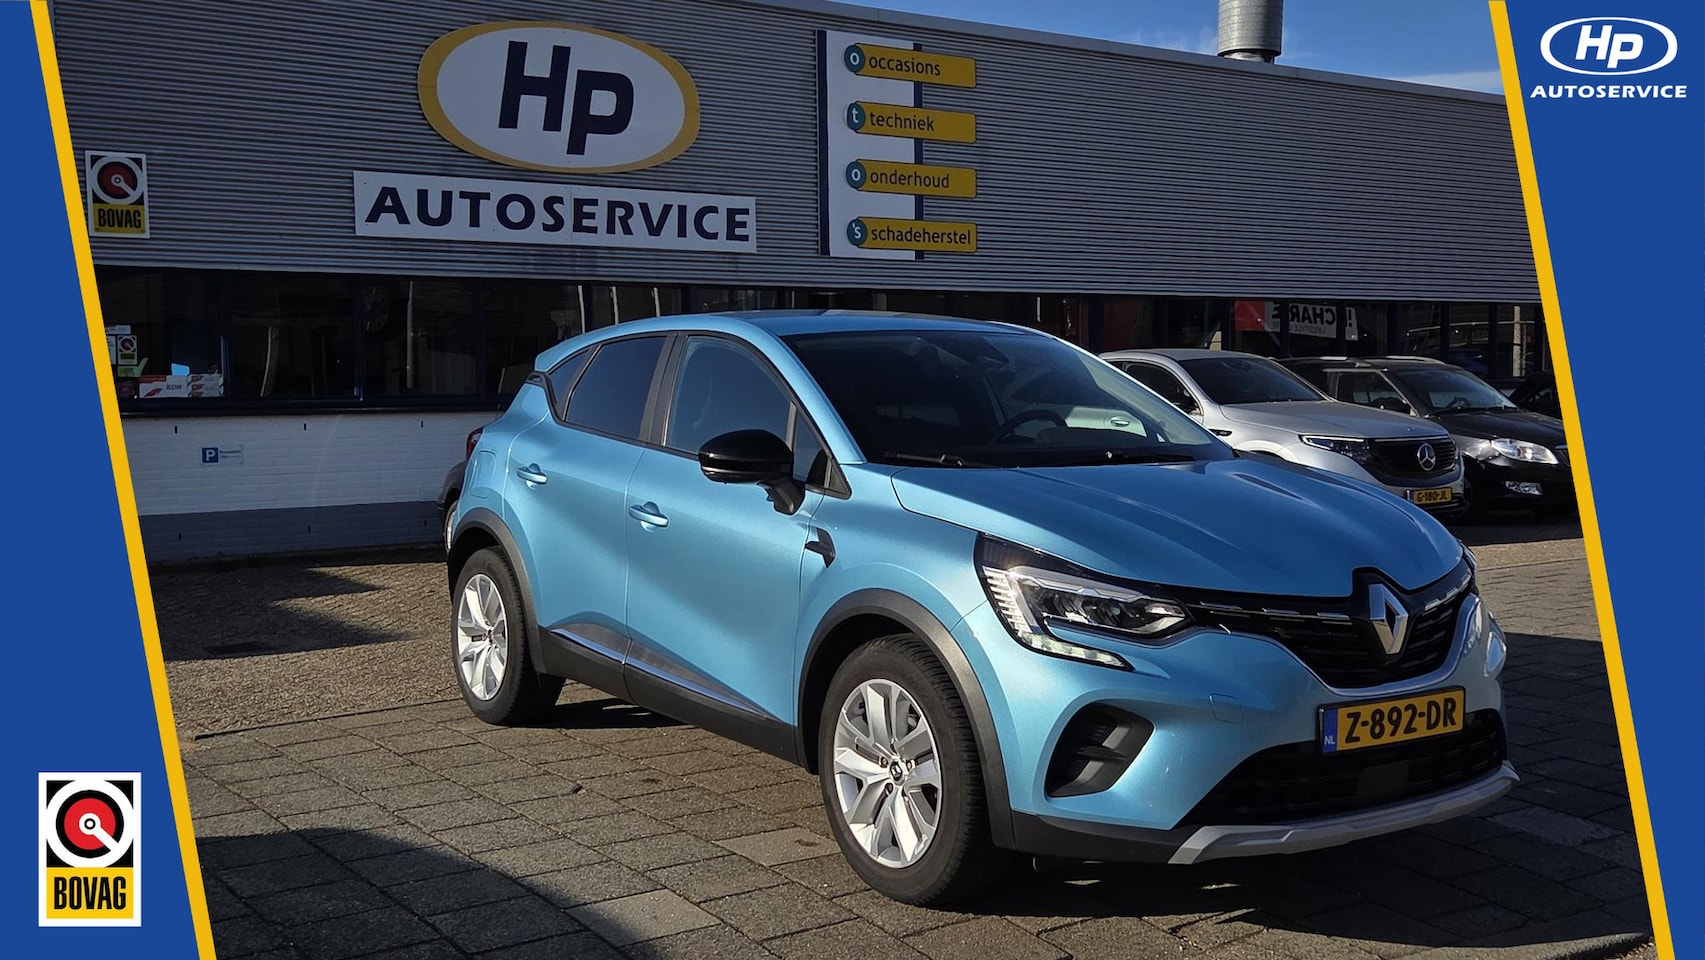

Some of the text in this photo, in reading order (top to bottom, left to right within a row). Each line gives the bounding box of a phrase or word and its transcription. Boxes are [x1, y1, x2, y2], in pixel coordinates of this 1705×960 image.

[869, 56, 941, 76] occasions
[851, 108, 934, 132] t techniek
[870, 169, 950, 189] onderhoud
[98, 208, 142, 229] BOVAG
[364, 186, 750, 241] AUTOSERVICE
[871, 226, 971, 245] schadeherstel
[206, 449, 216, 461] P
[1345, 697, 1456, 744] Z-892-DR
[1324, 735, 1336, 746] NL
